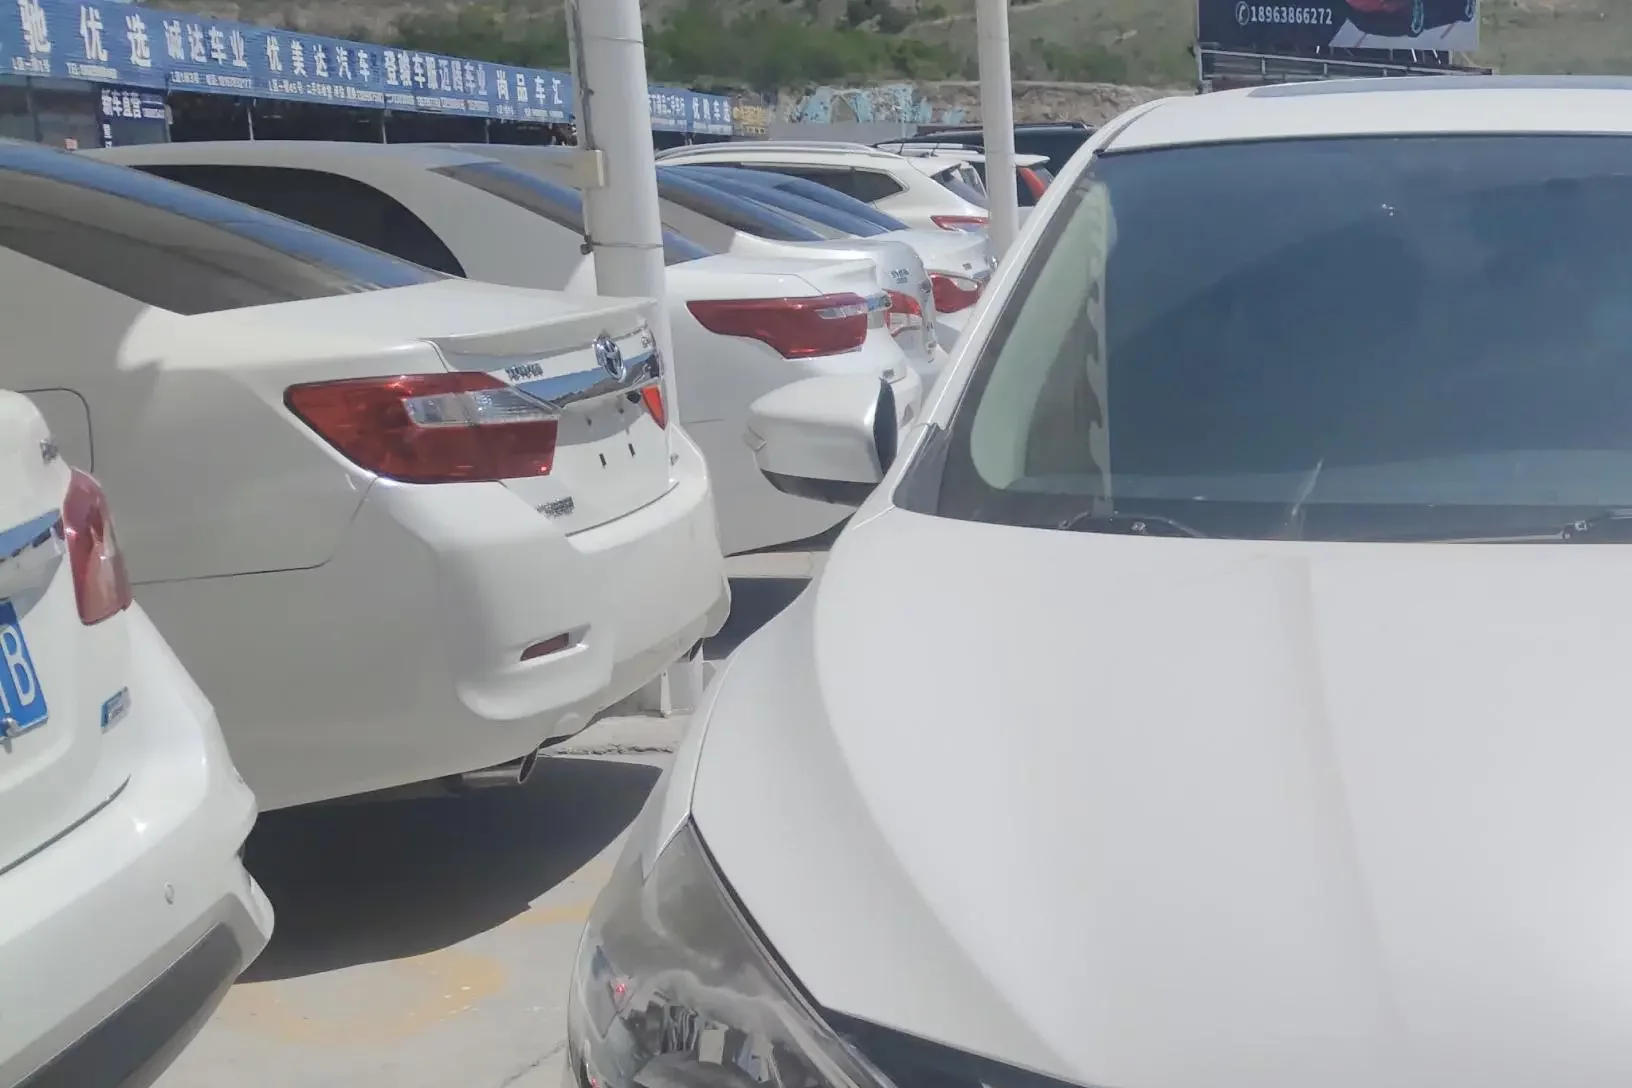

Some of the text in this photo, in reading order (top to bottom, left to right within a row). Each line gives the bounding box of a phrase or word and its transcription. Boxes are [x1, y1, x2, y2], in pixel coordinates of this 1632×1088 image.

[1250, 6, 1333, 25] 18963866272
[163, 20, 248, 67] 诚达车业
[266, 35, 371, 82] 优美达汽车
[497, 69, 563, 105] 尚品车汇
[0, 624, 36, 714] B
